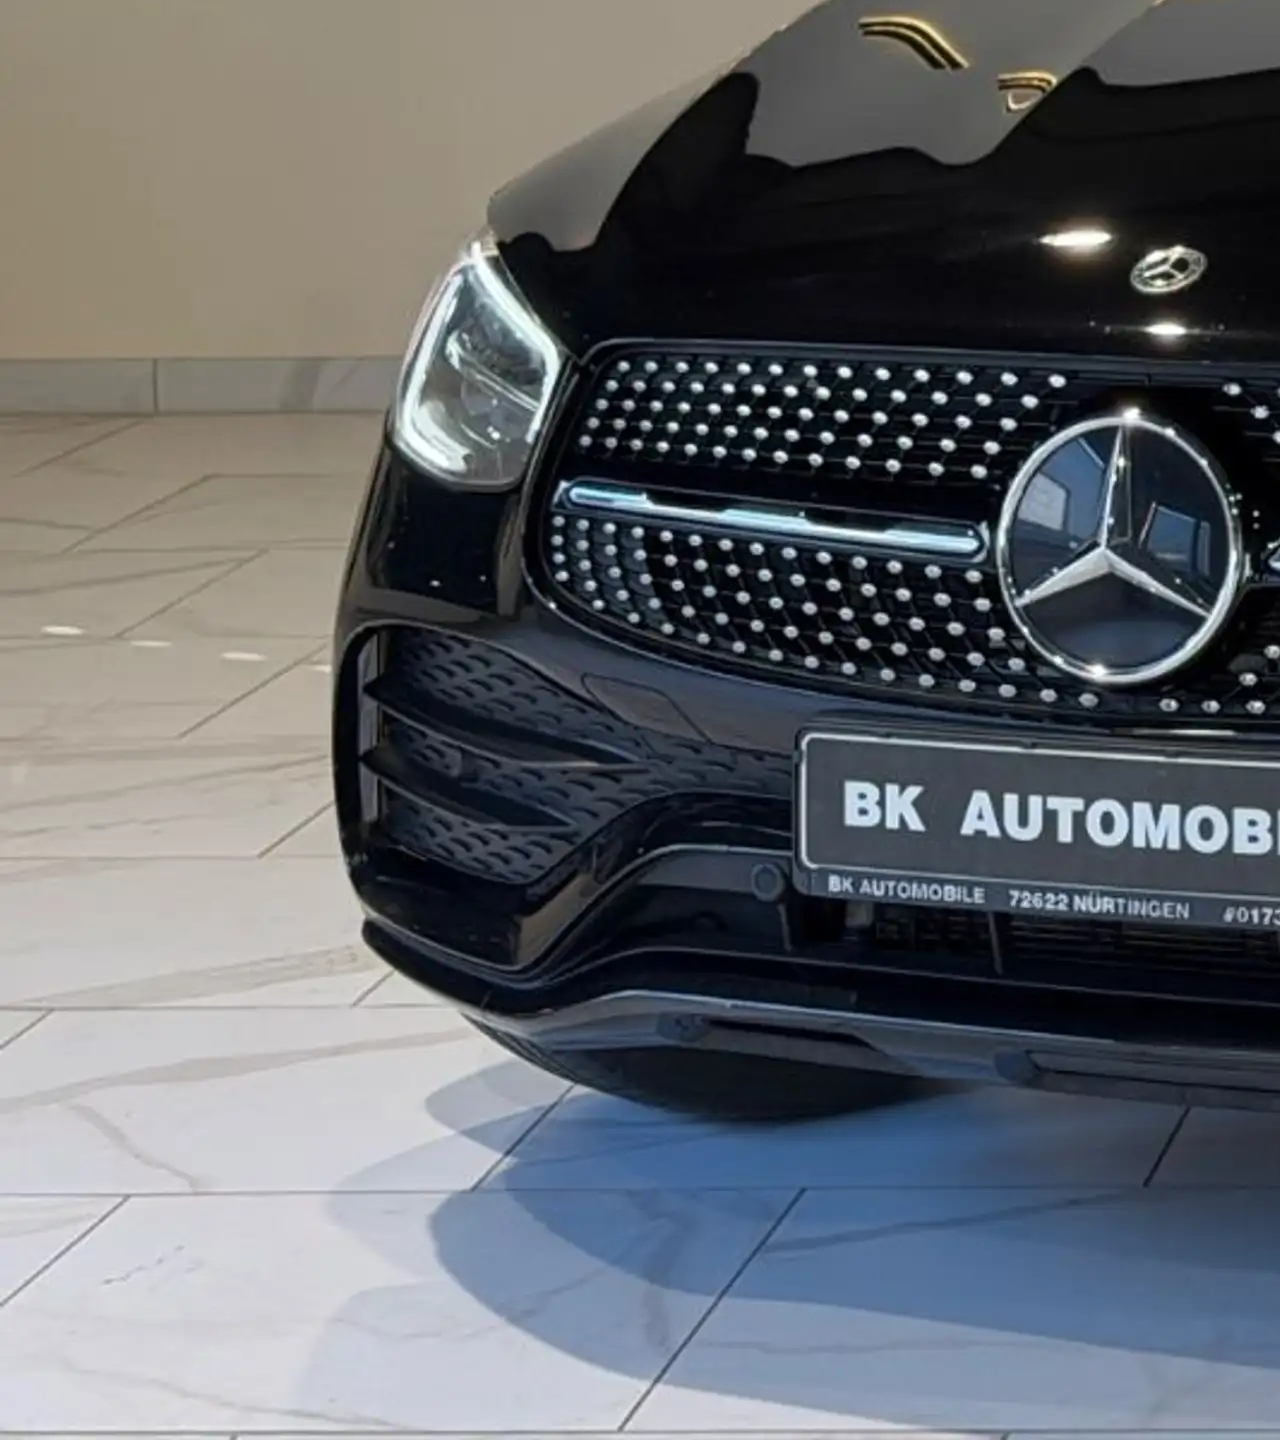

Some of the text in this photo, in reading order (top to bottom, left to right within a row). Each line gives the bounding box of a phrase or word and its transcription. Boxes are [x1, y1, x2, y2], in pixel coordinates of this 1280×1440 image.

[842, 779, 925, 833] BK
[827, 873, 855, 894] BK
[858, 878, 986, 904] AUTOMOBILE
[1007, 889, 1070, 911] 72622
[1072, 890, 1190, 920] NÜRTINGEN
